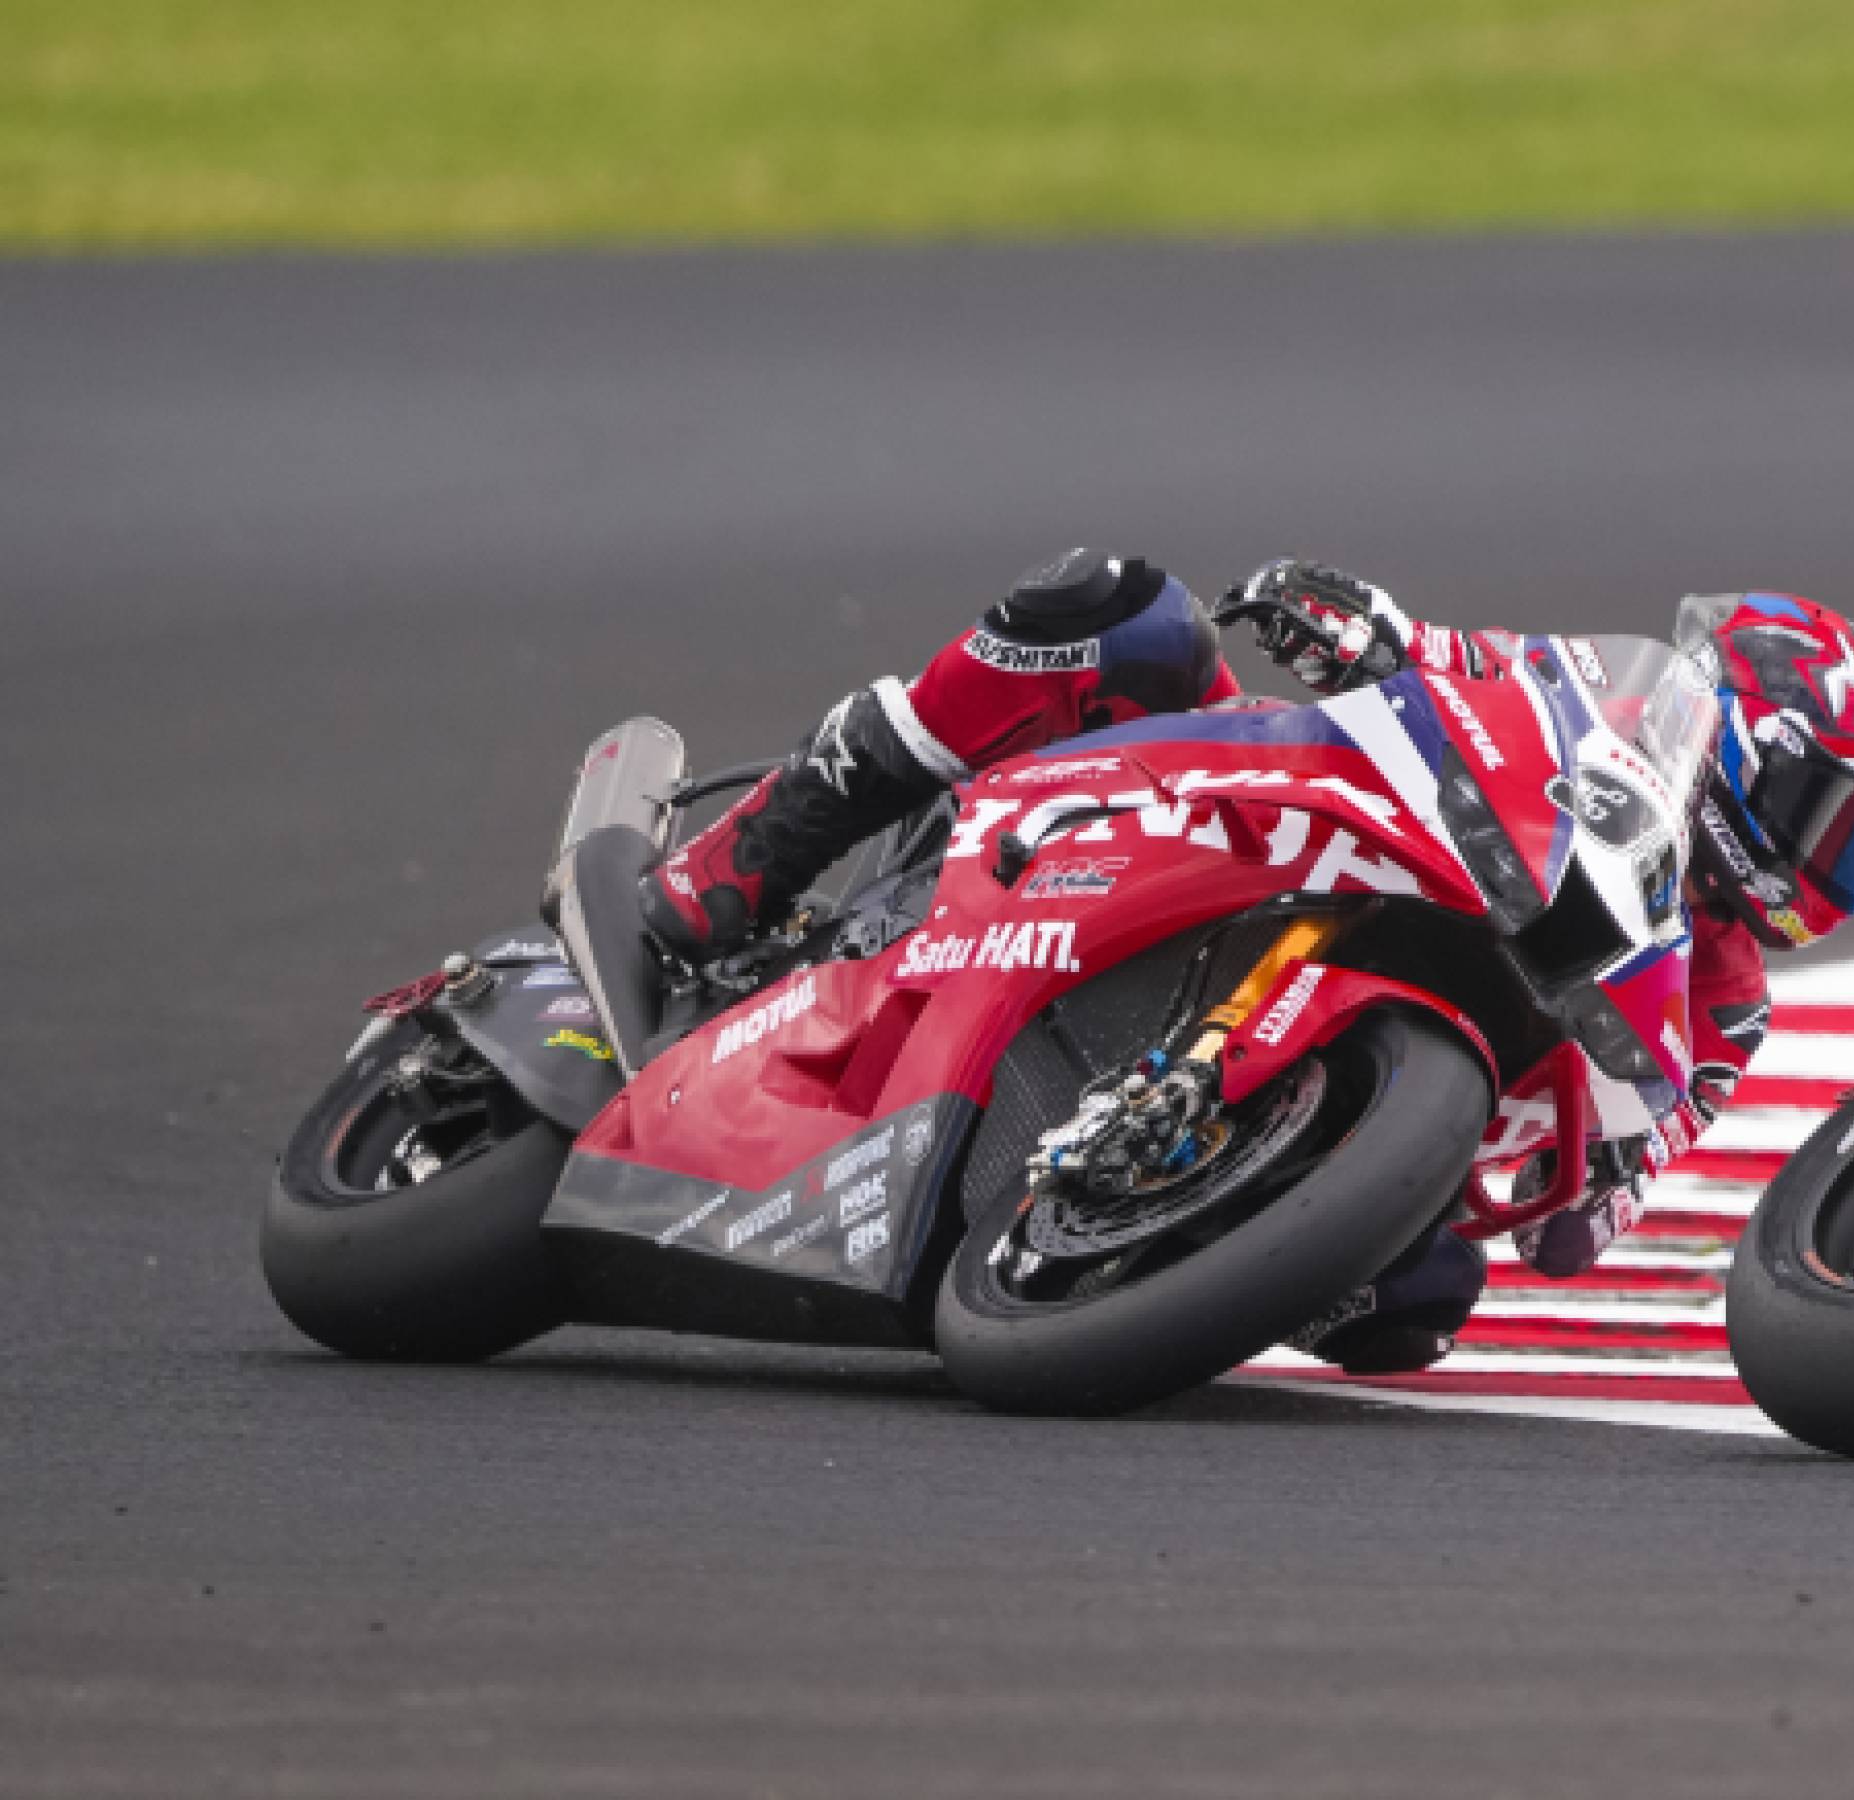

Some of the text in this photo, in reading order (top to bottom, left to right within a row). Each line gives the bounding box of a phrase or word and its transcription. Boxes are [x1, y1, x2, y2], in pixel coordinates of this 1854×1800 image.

[1425, 673, 1503, 770] MOTUL
[897, 921, 1080, 976] Satu HATI.
[712, 977, 816, 1063] MOTUL
